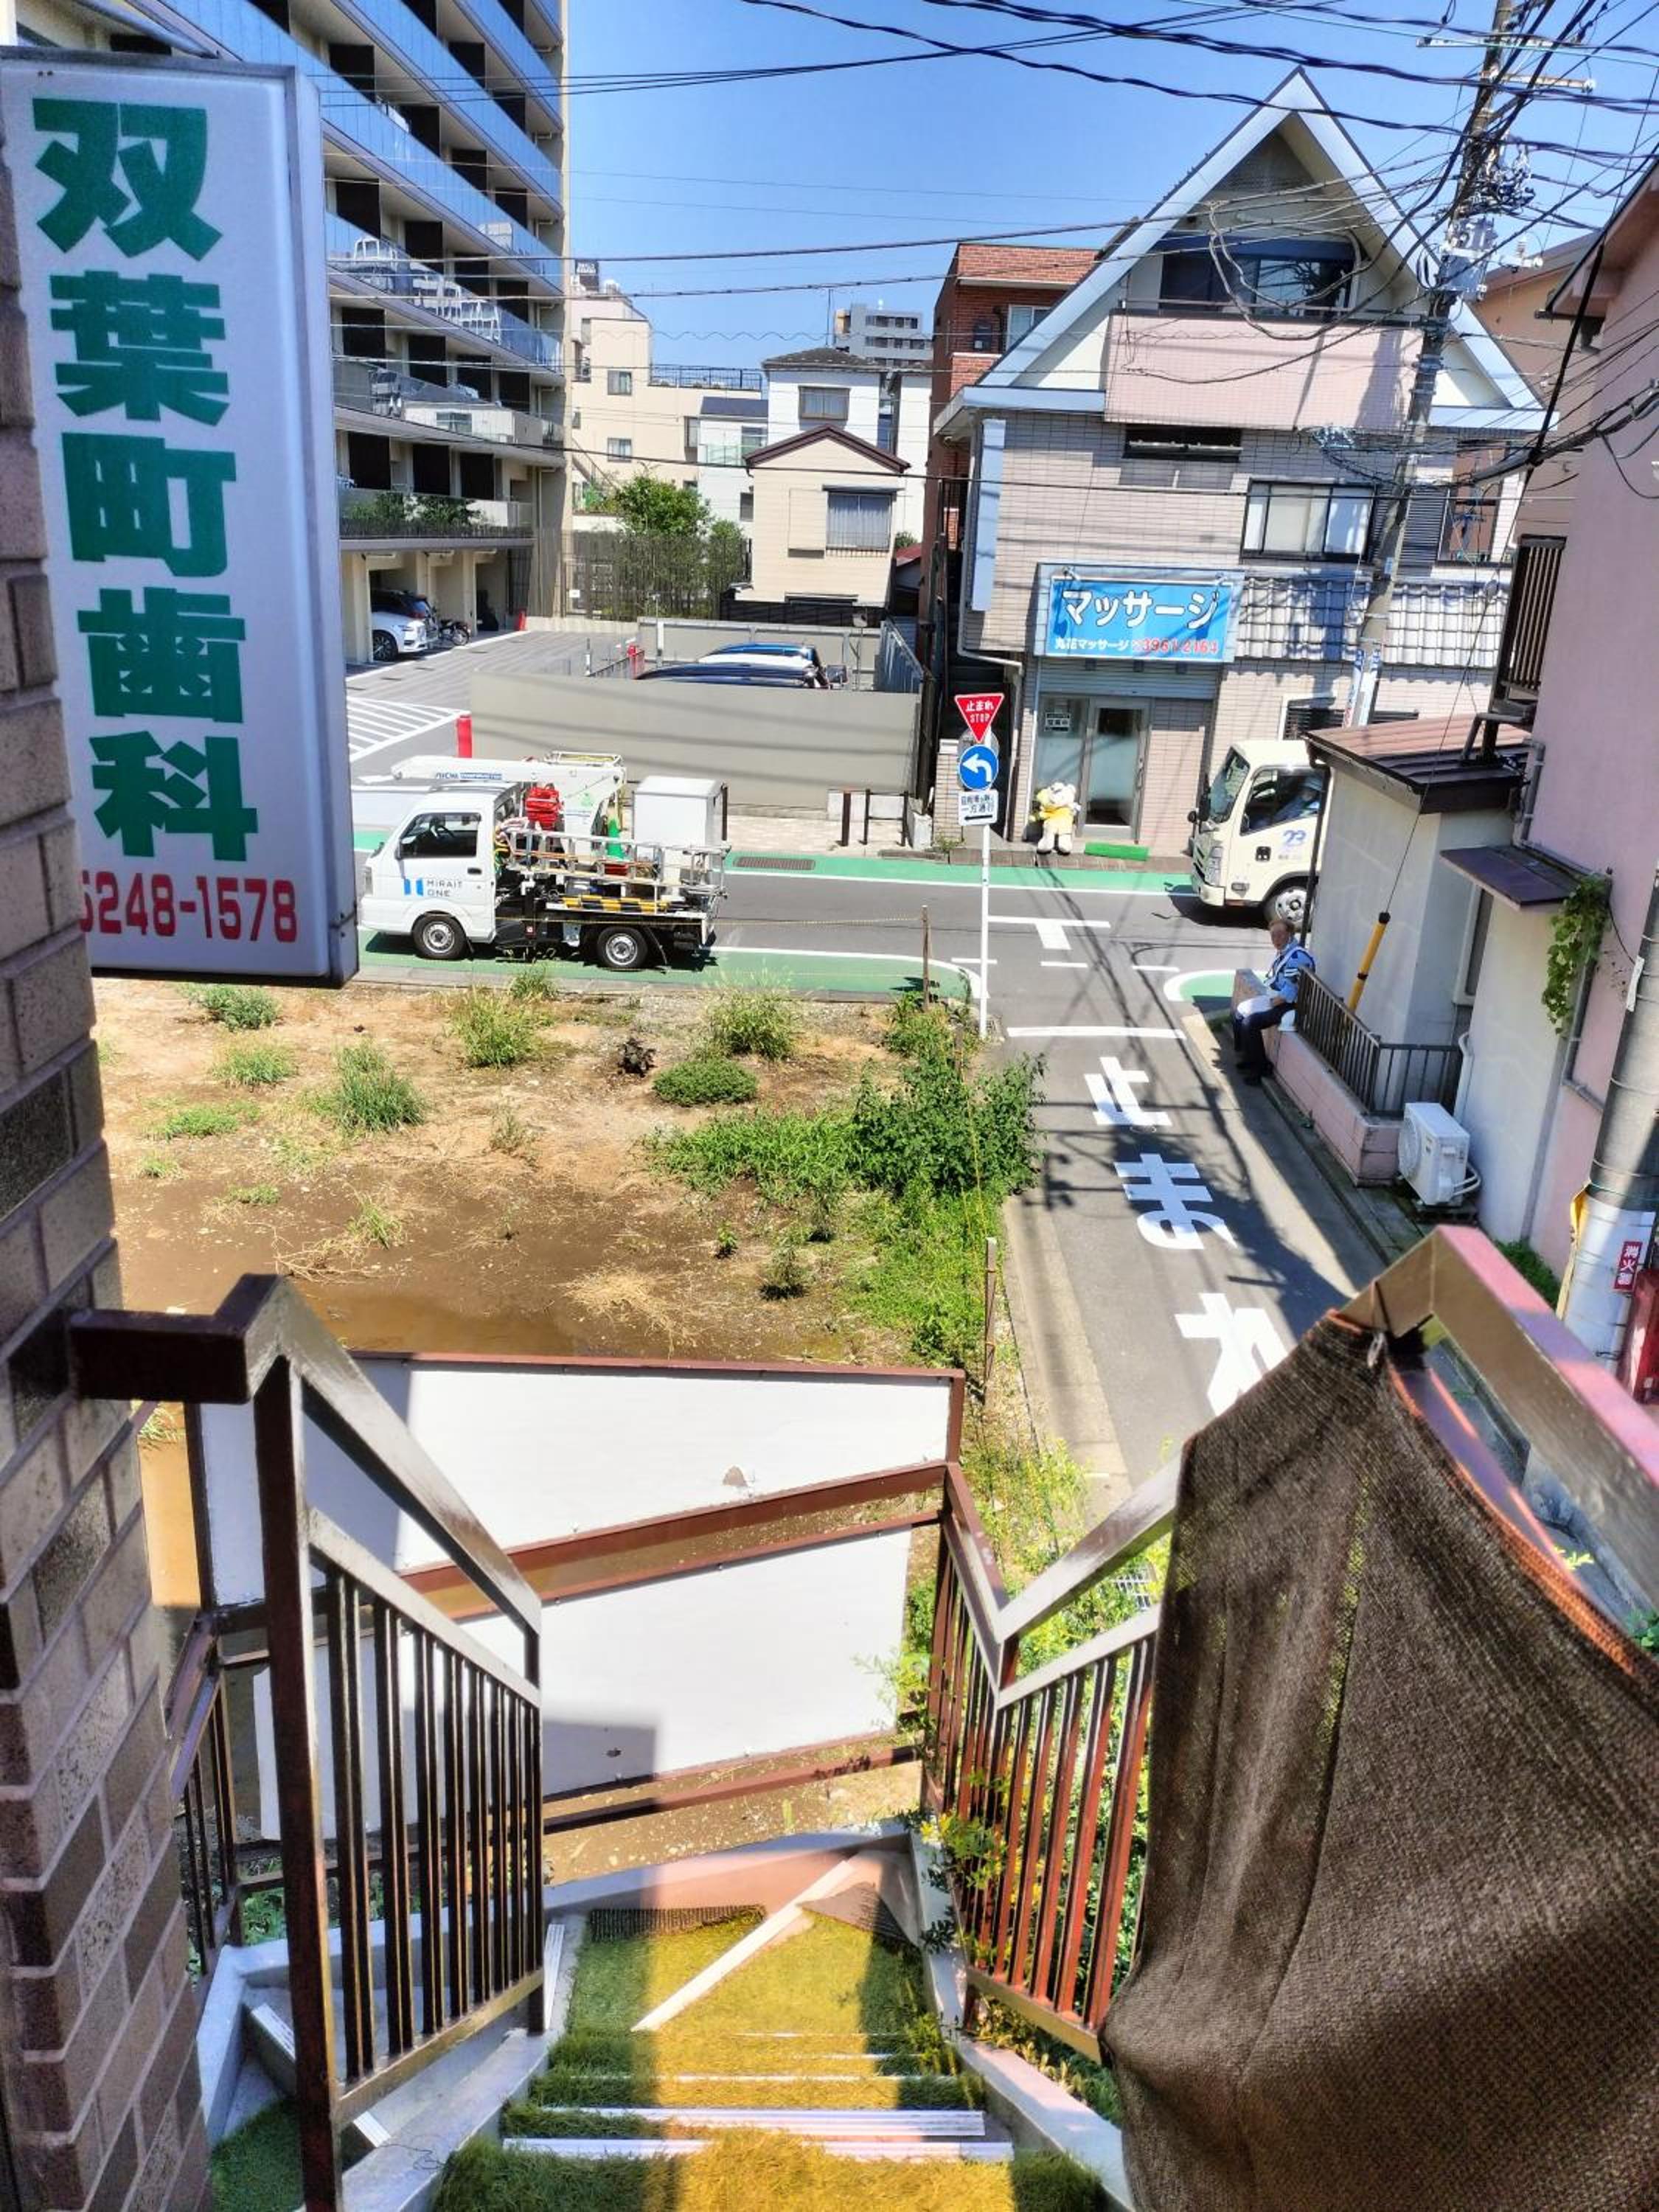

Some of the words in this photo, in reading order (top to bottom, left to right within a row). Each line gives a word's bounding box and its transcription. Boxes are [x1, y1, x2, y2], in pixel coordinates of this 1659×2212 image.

[32, 97, 259, 861] 双葉町歯科
[1062, 589, 1220, 629] マッサージ
[965, 700, 995, 712] 止まれ
[970, 713, 990, 723] STOP
[427, 889, 450, 897] ONE
[1617, 1245, 1639, 1285] 消火器
